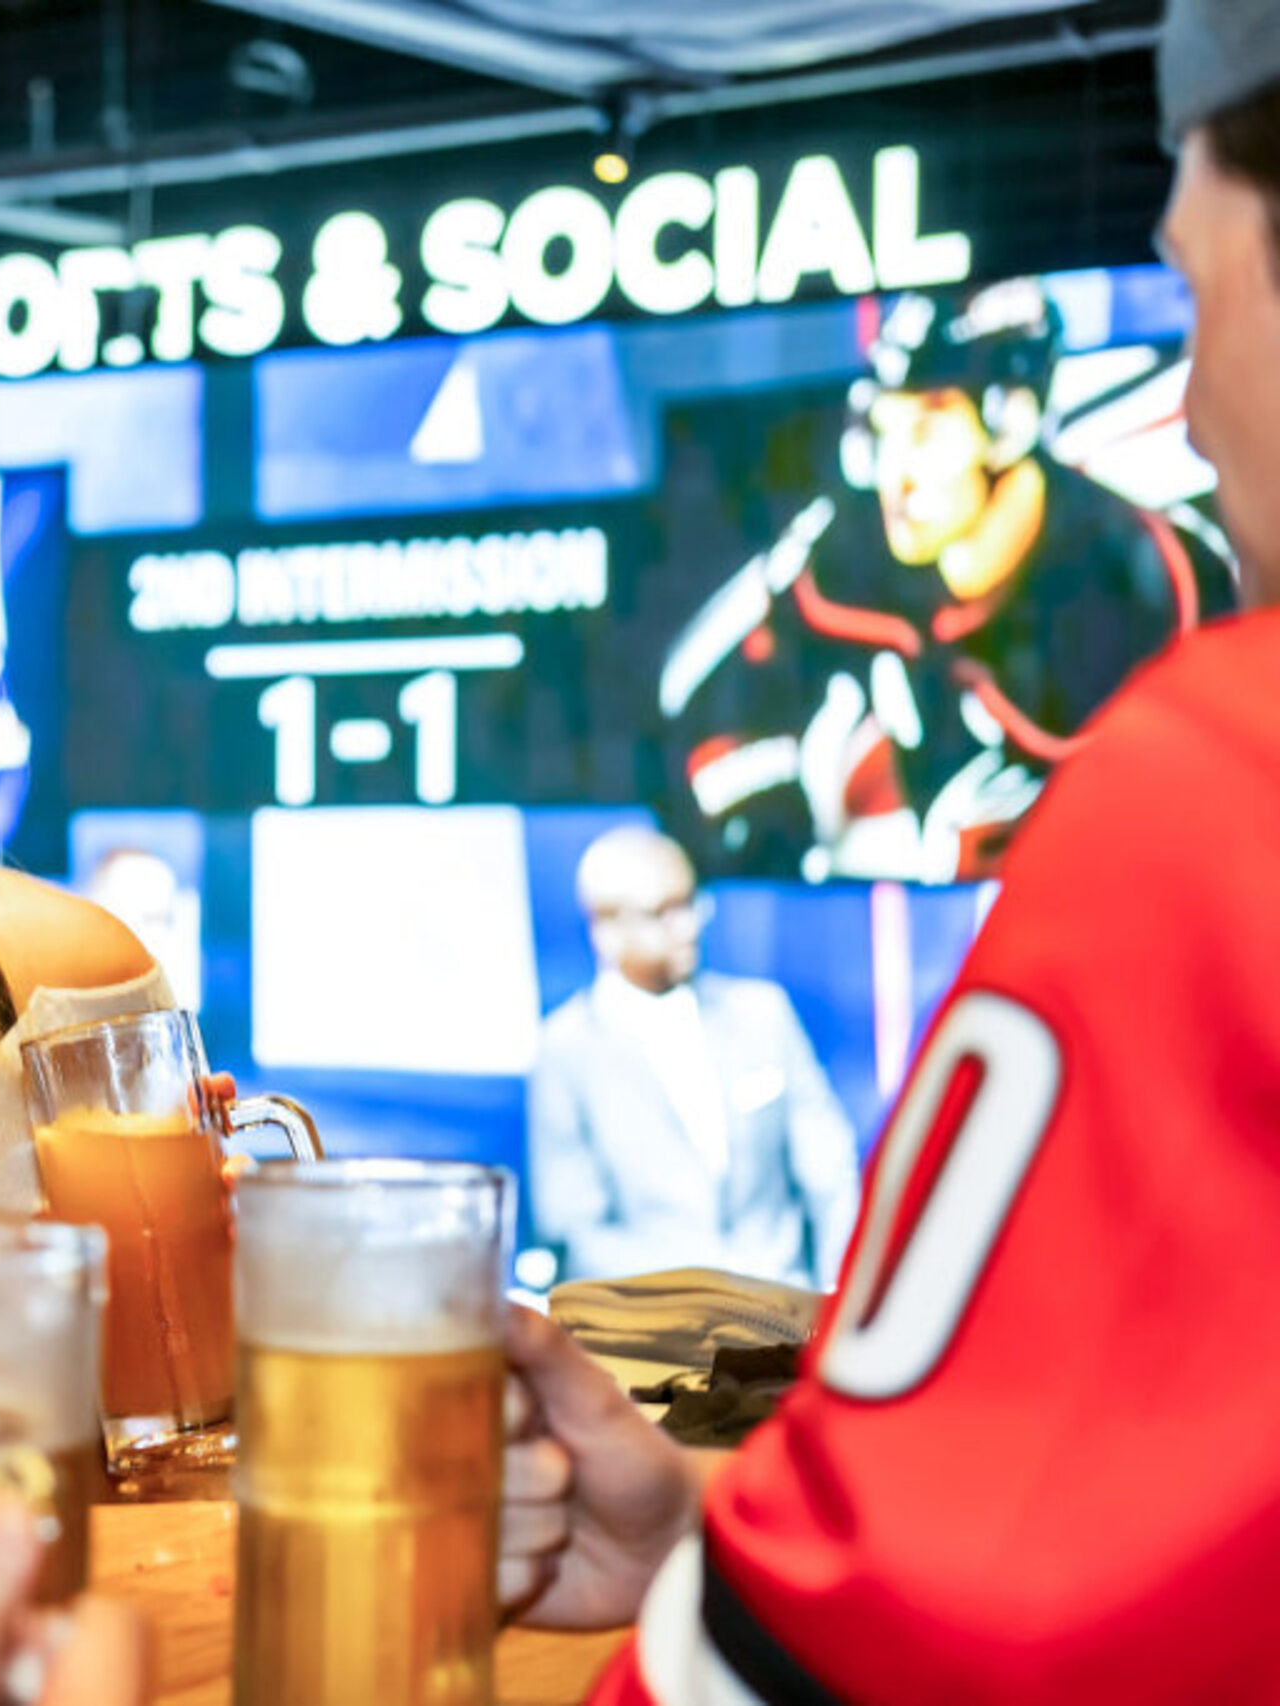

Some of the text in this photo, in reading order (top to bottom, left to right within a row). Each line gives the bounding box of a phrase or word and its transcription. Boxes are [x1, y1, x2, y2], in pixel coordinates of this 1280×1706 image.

[302, 211, 403, 346] &
[420, 145, 972, 334] SOCIAL
[236, 527, 608, 627] INTERMISSION
